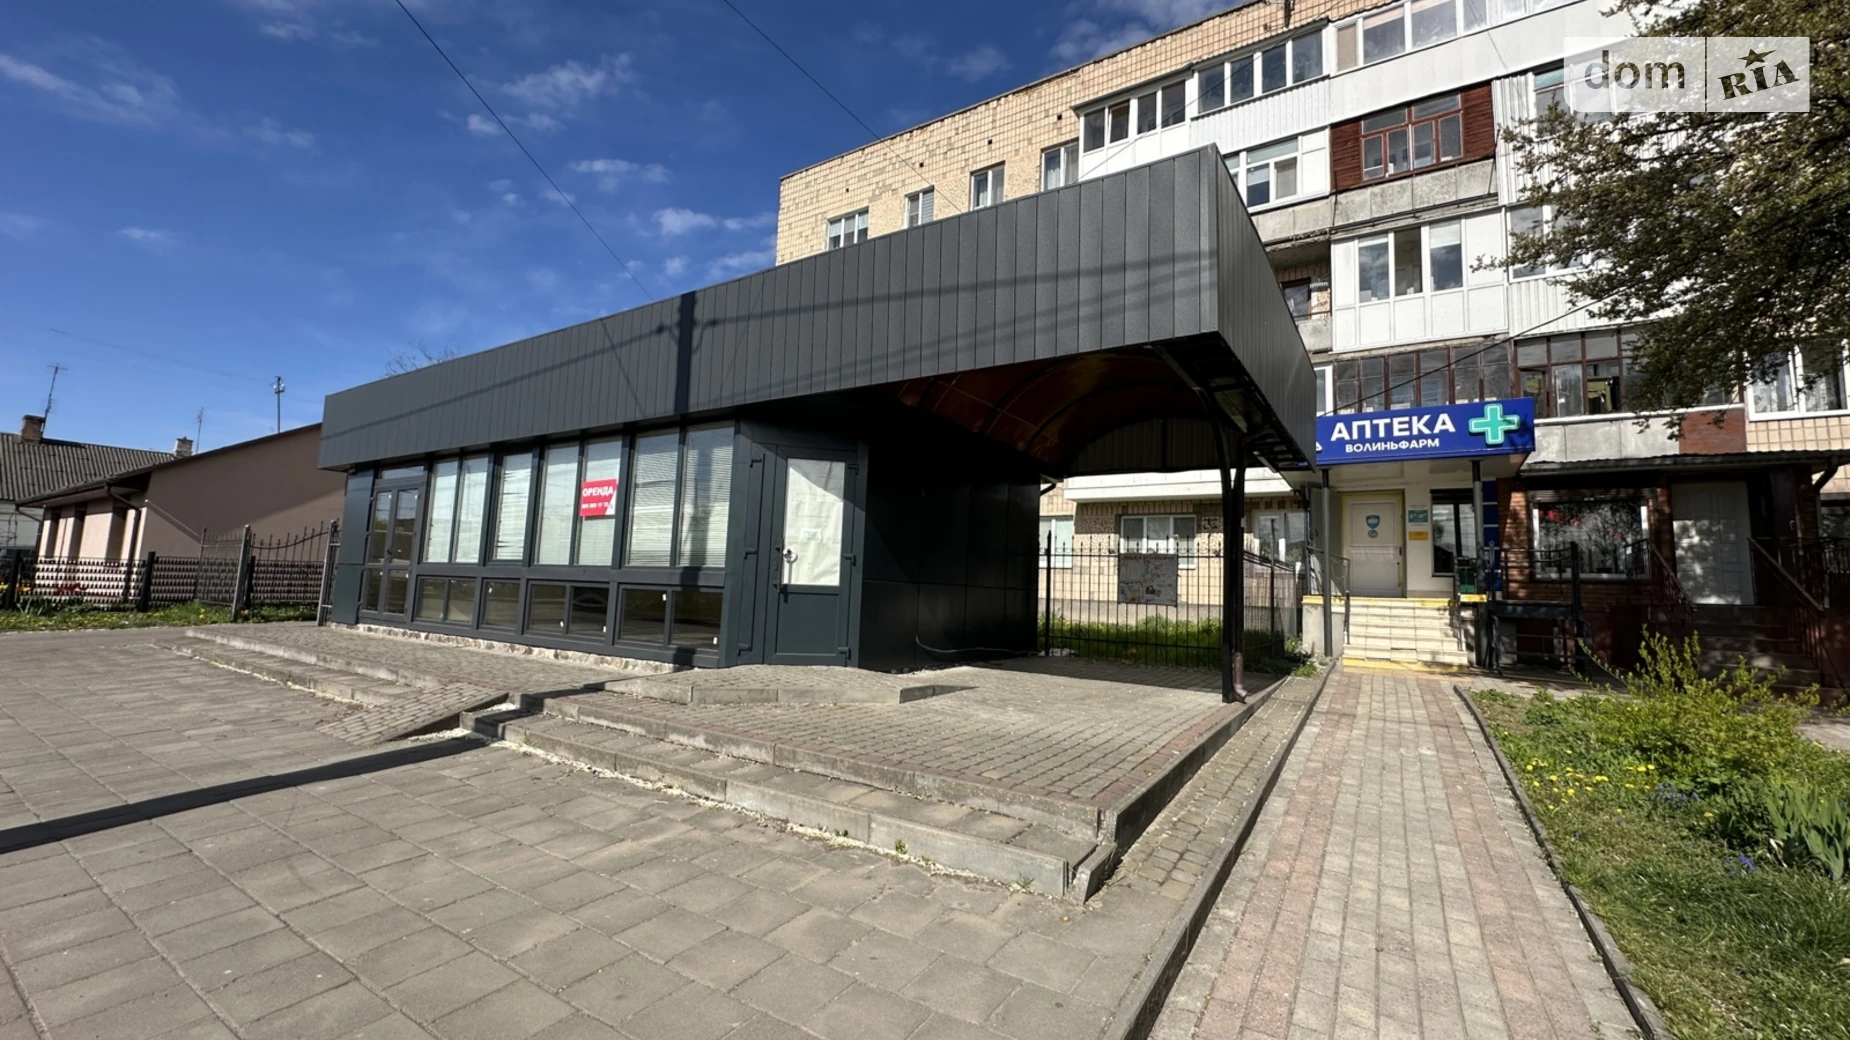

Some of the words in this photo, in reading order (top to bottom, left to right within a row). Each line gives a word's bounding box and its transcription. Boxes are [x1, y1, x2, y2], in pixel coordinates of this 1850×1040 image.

[1330, 413, 1456, 441] АПТЕКА
[1345, 438, 1440, 453] ВОЛИНЬФАРМ
[582, 486, 613, 497] ОРЕНДА
